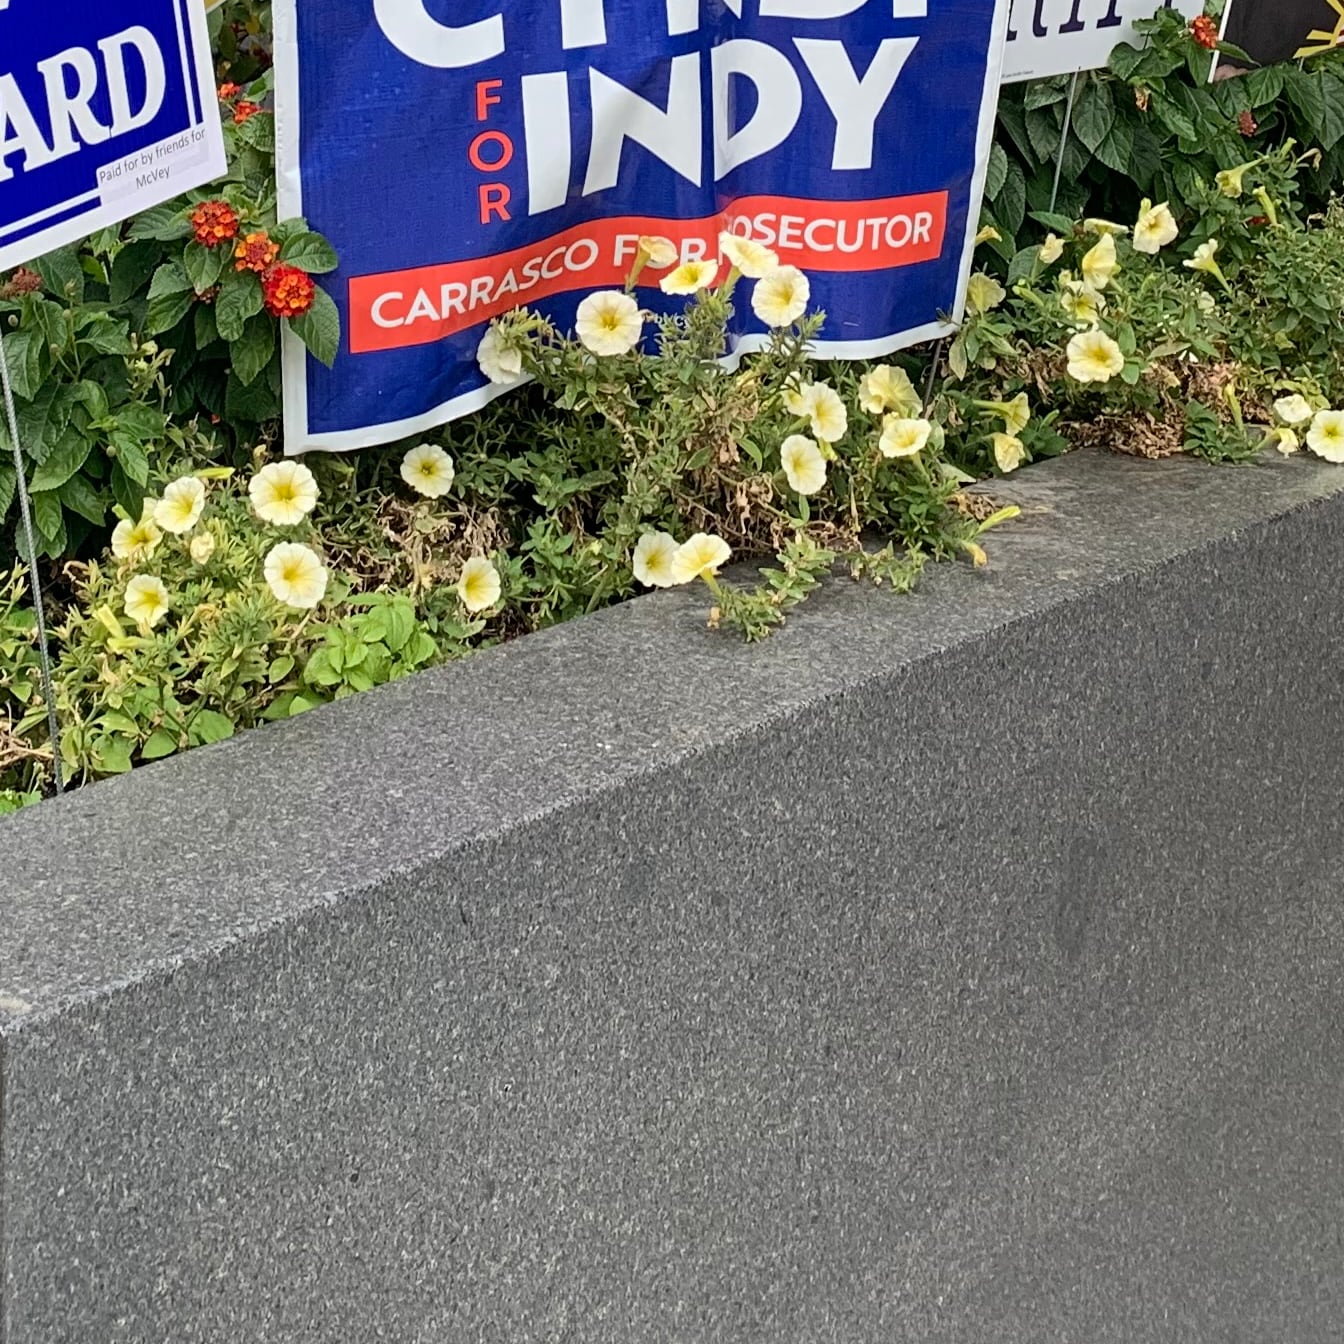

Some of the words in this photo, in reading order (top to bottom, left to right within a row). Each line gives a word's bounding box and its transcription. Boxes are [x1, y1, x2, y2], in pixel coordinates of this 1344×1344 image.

[99, 165, 122, 183] Paid
[123, 158, 139, 173] for
[141, 151, 154, 166] by
[155, 136, 190, 159] friends
[191, 129, 206, 145] for
[468, 79, 514, 224] FOR
[521, 36, 921, 217] INDY
[135, 165, 171, 189] McVey
[370, 237, 599, 329] CARRASCO
[613, 234, 707, 269] FR
